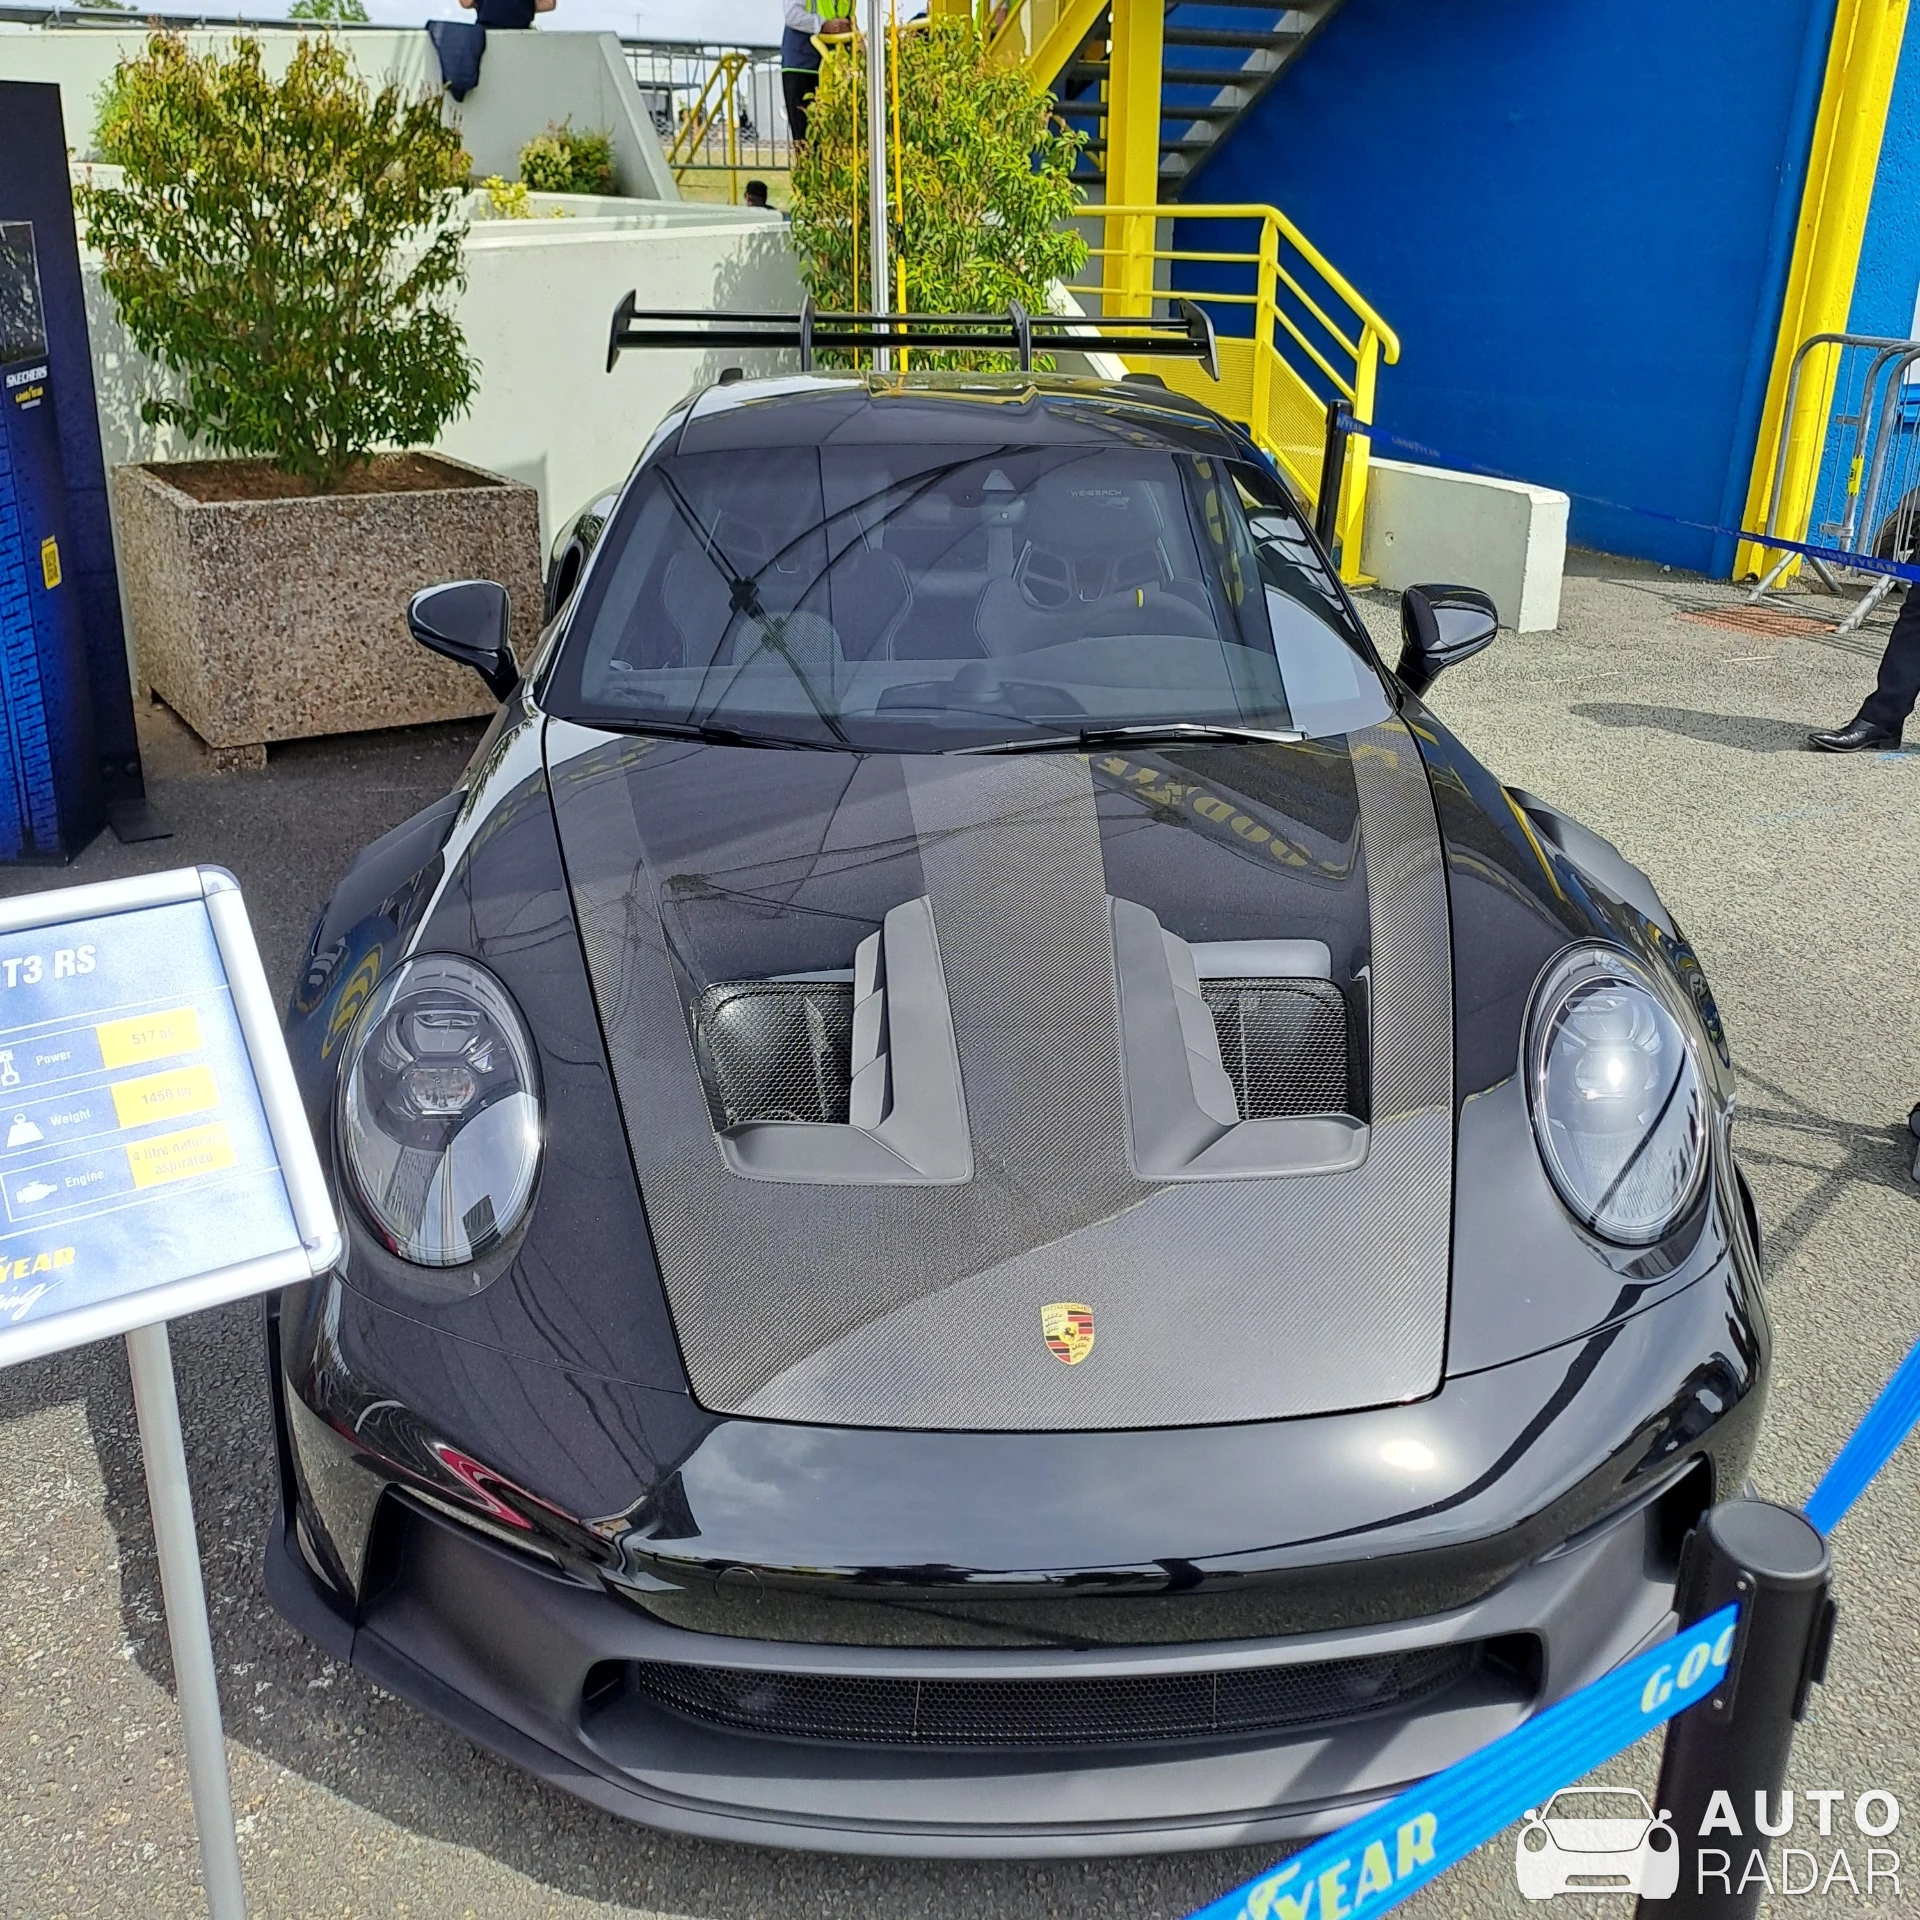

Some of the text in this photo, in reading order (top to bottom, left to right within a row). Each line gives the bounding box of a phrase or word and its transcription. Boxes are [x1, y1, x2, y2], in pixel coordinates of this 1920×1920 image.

[6, 365, 48, 389] SKECHERS
[1805, 546, 1897, 574] GOODYEAR
[2, 944, 97, 988] T3 RS
[132, 1030, 154, 1045] 517
[35, 1050, 73, 1067] Power
[141, 1088, 173, 1105] 1450
[50, 1108, 92, 1127] Weight
[133, 1151, 141, 1162] 4
[64, 1170, 105, 1189] Engine
[1043, 1304, 1091, 1313] PORSCHE
